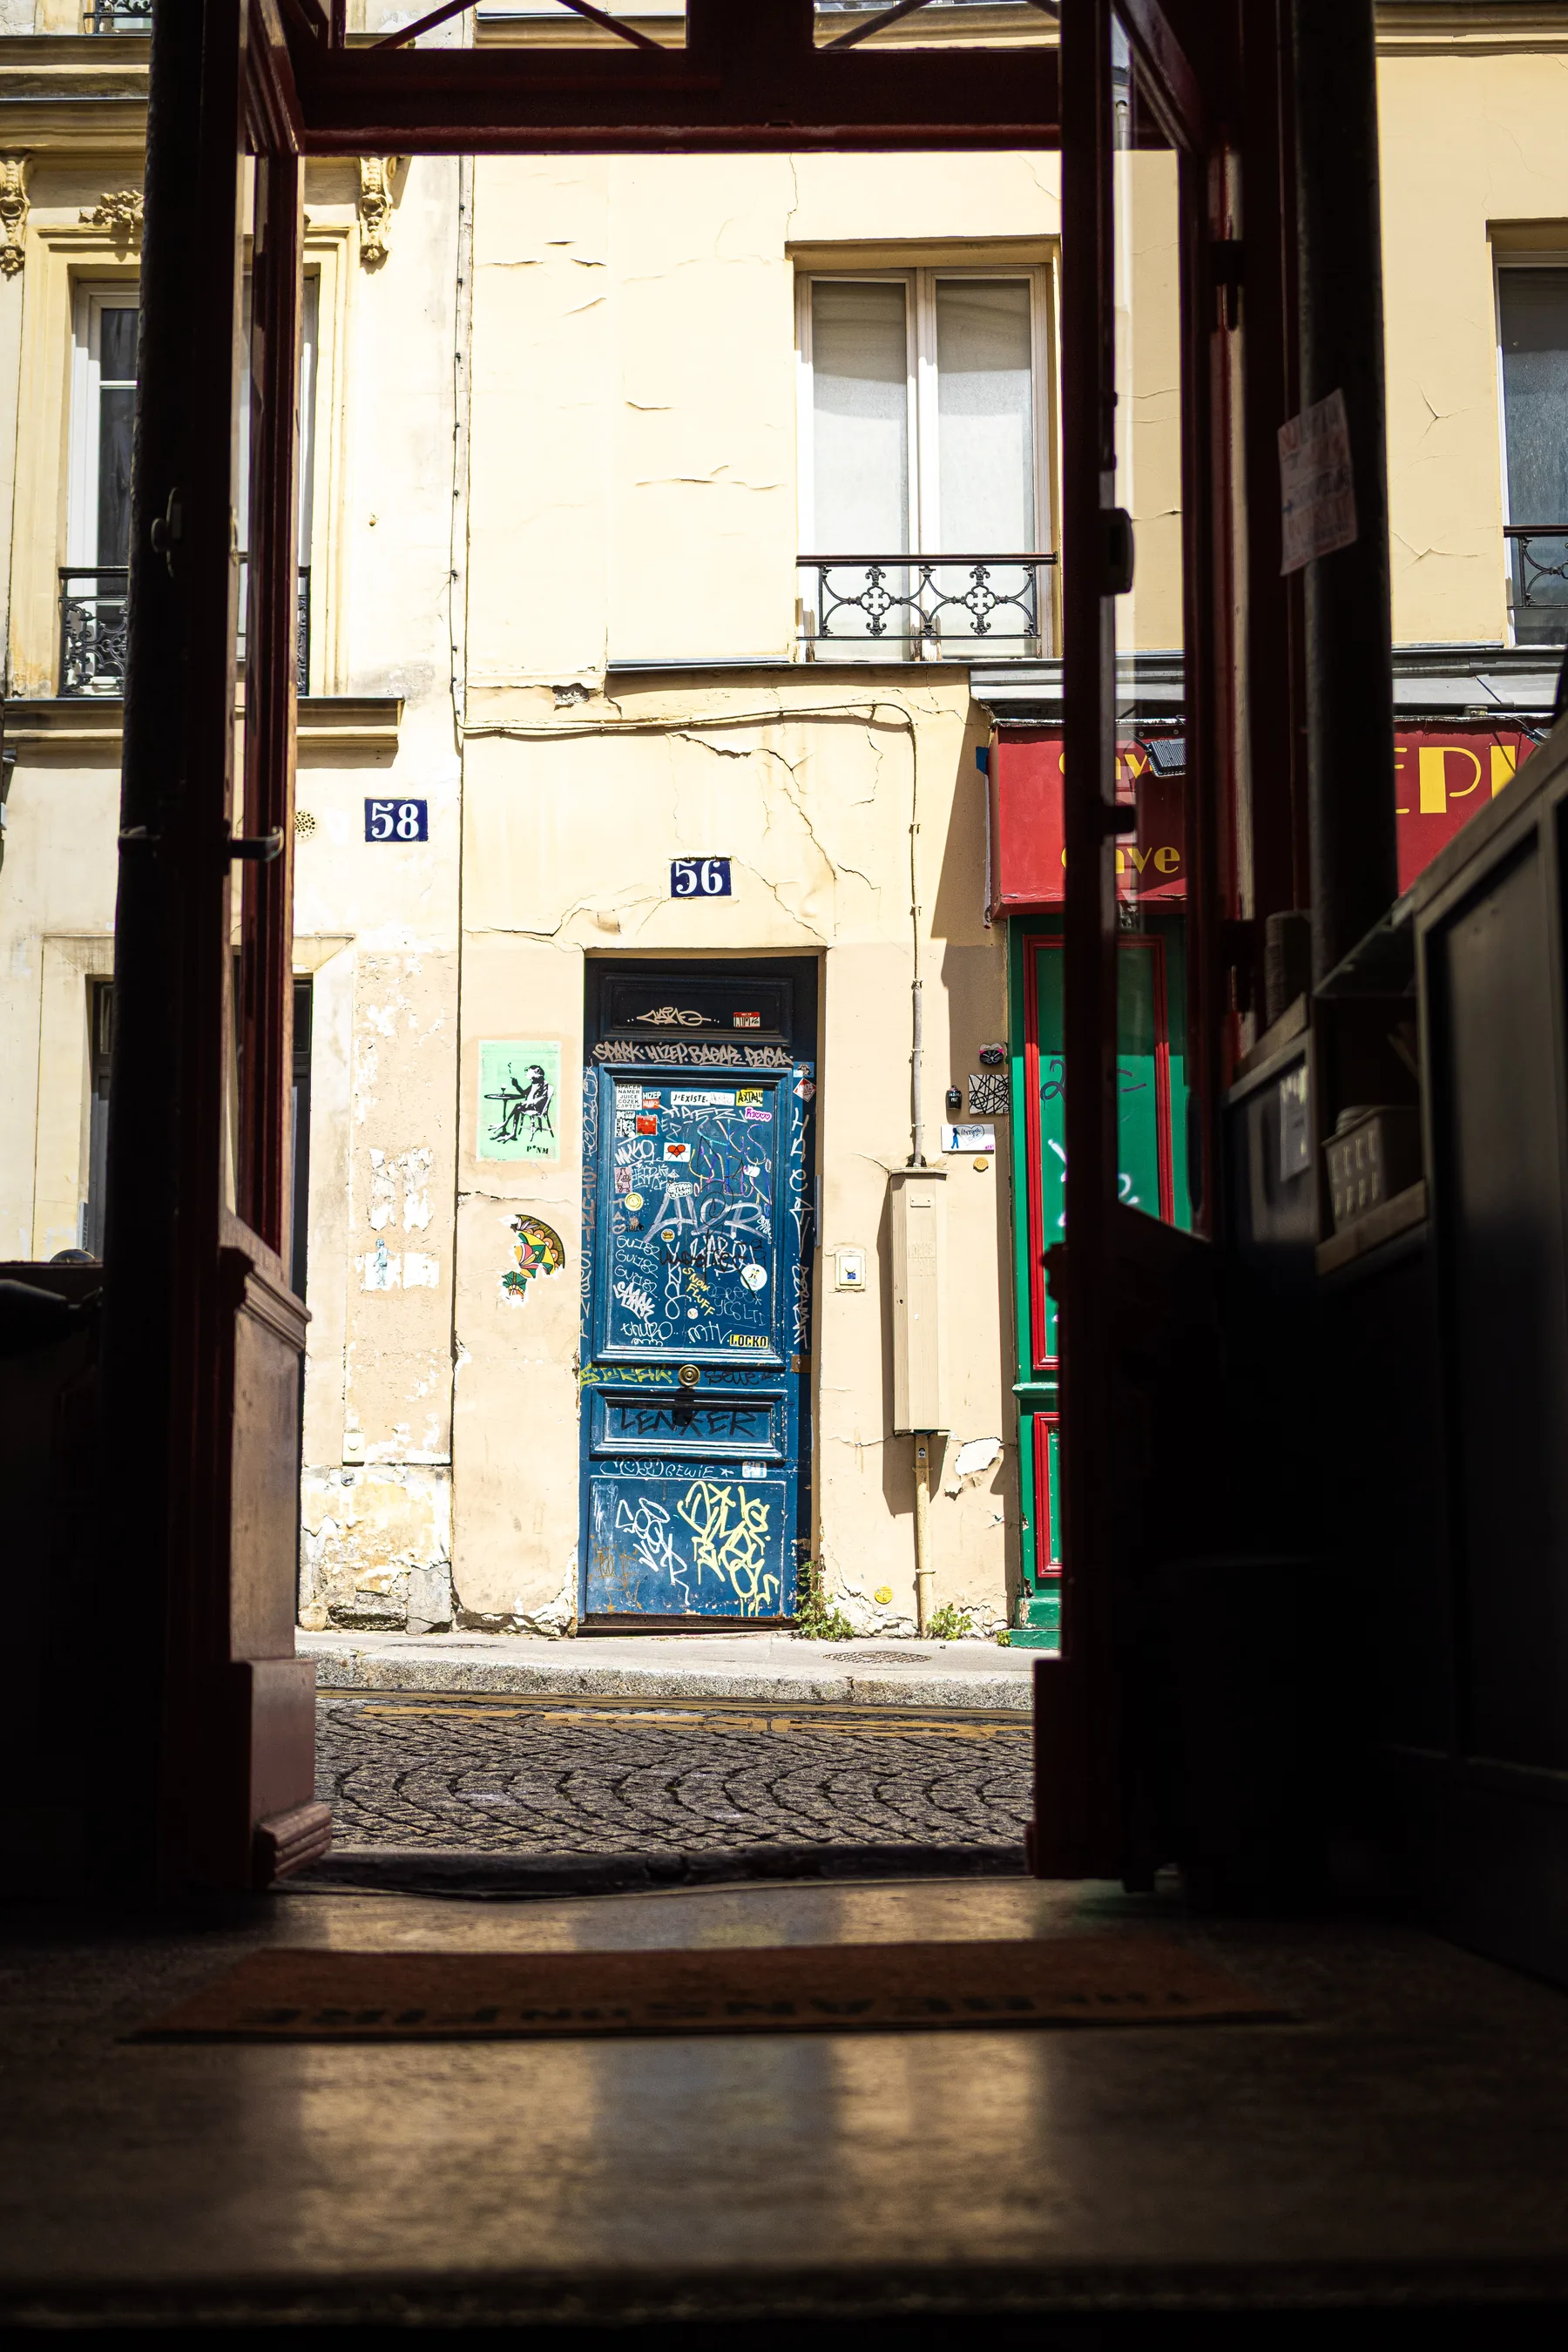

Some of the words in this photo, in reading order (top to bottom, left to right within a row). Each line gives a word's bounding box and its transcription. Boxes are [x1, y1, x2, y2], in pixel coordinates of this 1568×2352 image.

[371, 801, 419, 839] 58
[675, 860, 723, 895] 56
[682, 1267, 711, 1293] SNOW
[686, 1282, 716, 1316] FLUFF
[731, 1335, 767, 1348] LOCKO
